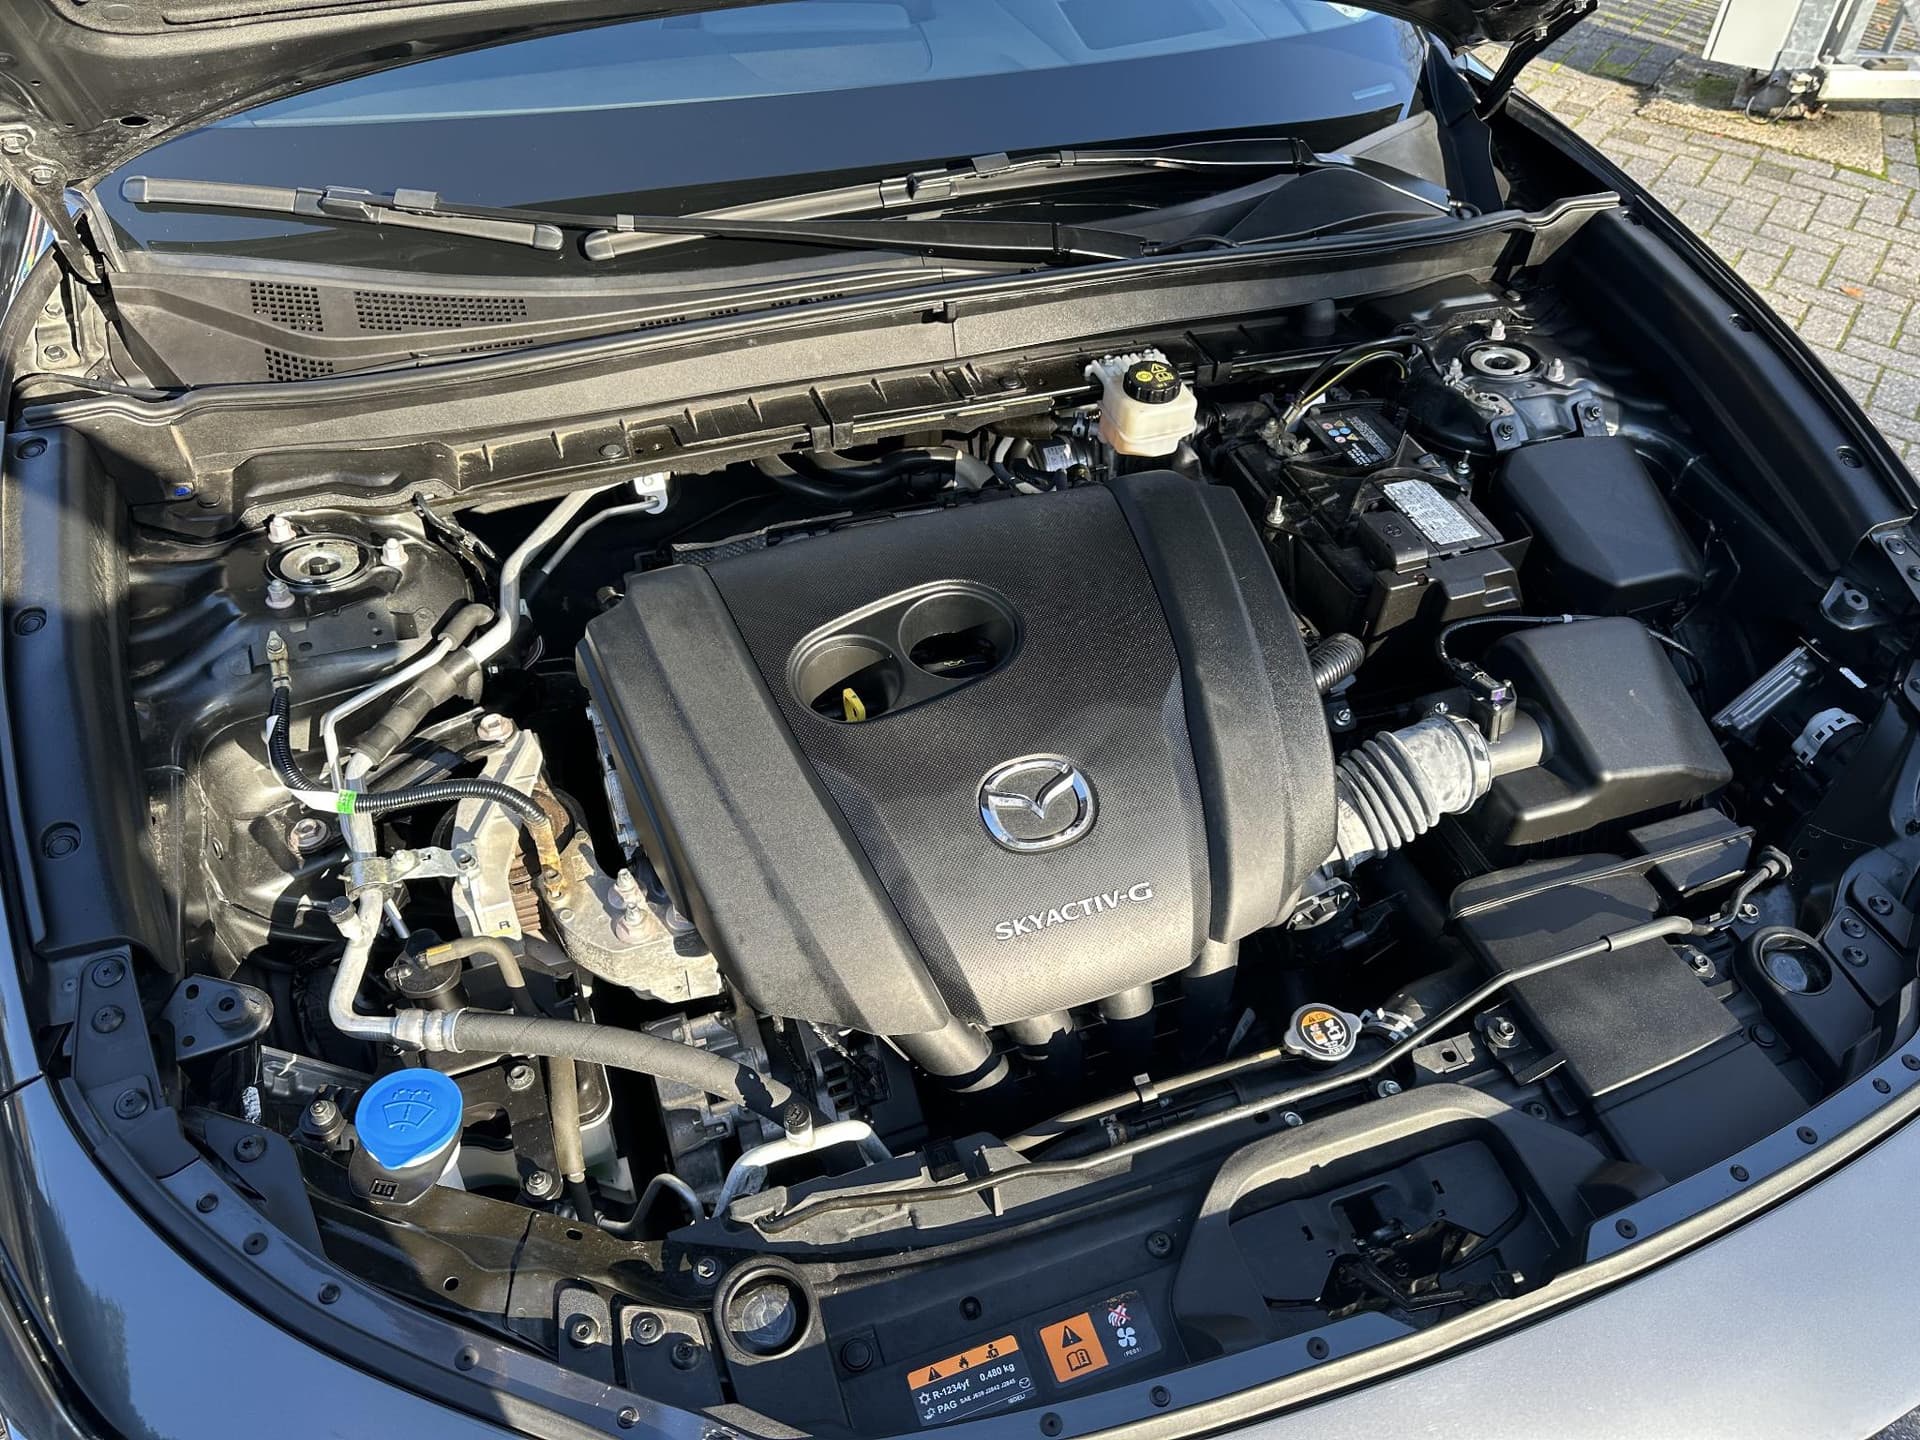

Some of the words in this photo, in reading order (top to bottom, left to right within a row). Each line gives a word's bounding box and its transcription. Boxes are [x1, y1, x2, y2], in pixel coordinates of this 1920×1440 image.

[995, 882, 1153, 940] SKYACTIV-G
[932, 1379, 970, 1400] R-1234yf
[979, 1366, 1002, 1382] 0.480
[1002, 1362, 1015, 1374] kg
[937, 1400, 958, 1414] PAG
[959, 1396, 972, 1404] SAE
